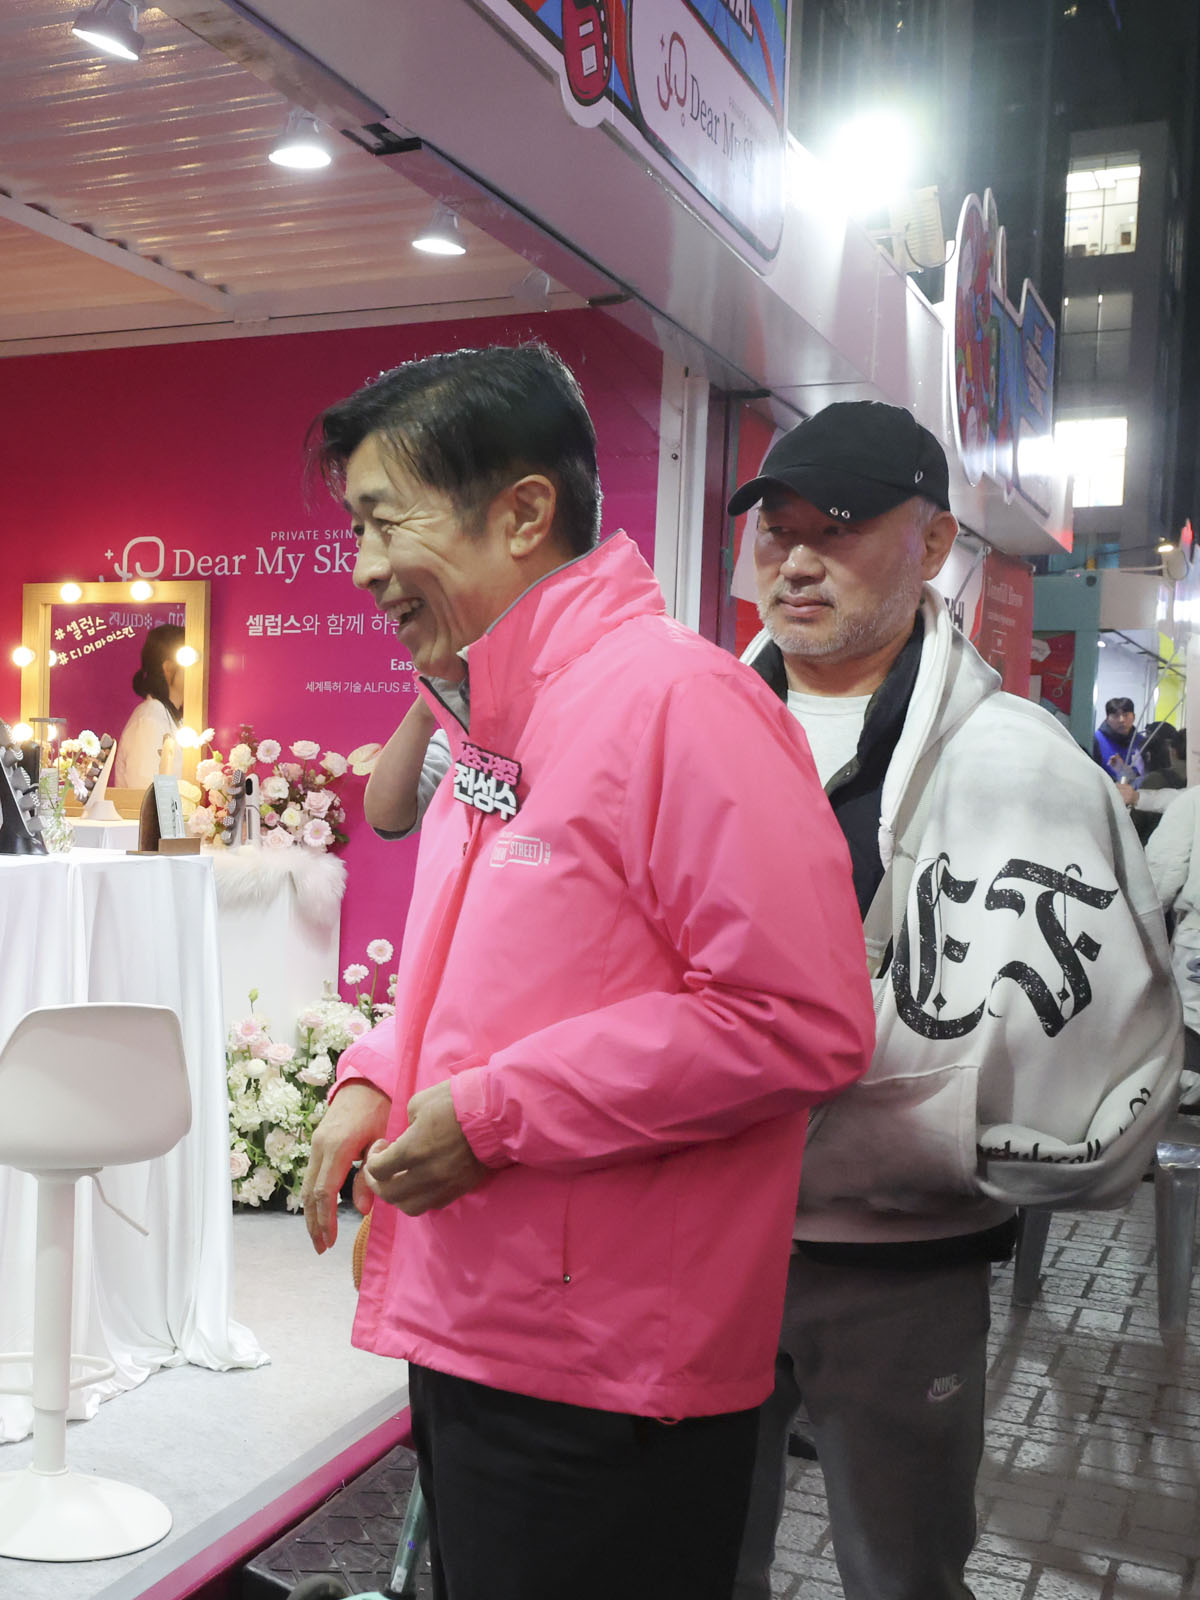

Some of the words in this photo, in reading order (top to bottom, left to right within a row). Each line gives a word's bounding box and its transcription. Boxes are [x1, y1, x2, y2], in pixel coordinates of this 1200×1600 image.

[690, 74, 720, 145] Dear
[271, 530, 319, 541] PRIVATE
[172, 549, 246, 577] Dear
[255, 545, 305, 584] My
[246, 614, 321, 636] 셀럽스와
[327, 613, 364, 635] 함께
[305, 681, 342, 693] 세계특허
[344, 681, 362, 693] 기술
[363, 682, 400, 693] ALFUS
[453, 762, 517, 821] 전성수
[509, 841, 539, 859] STREET
